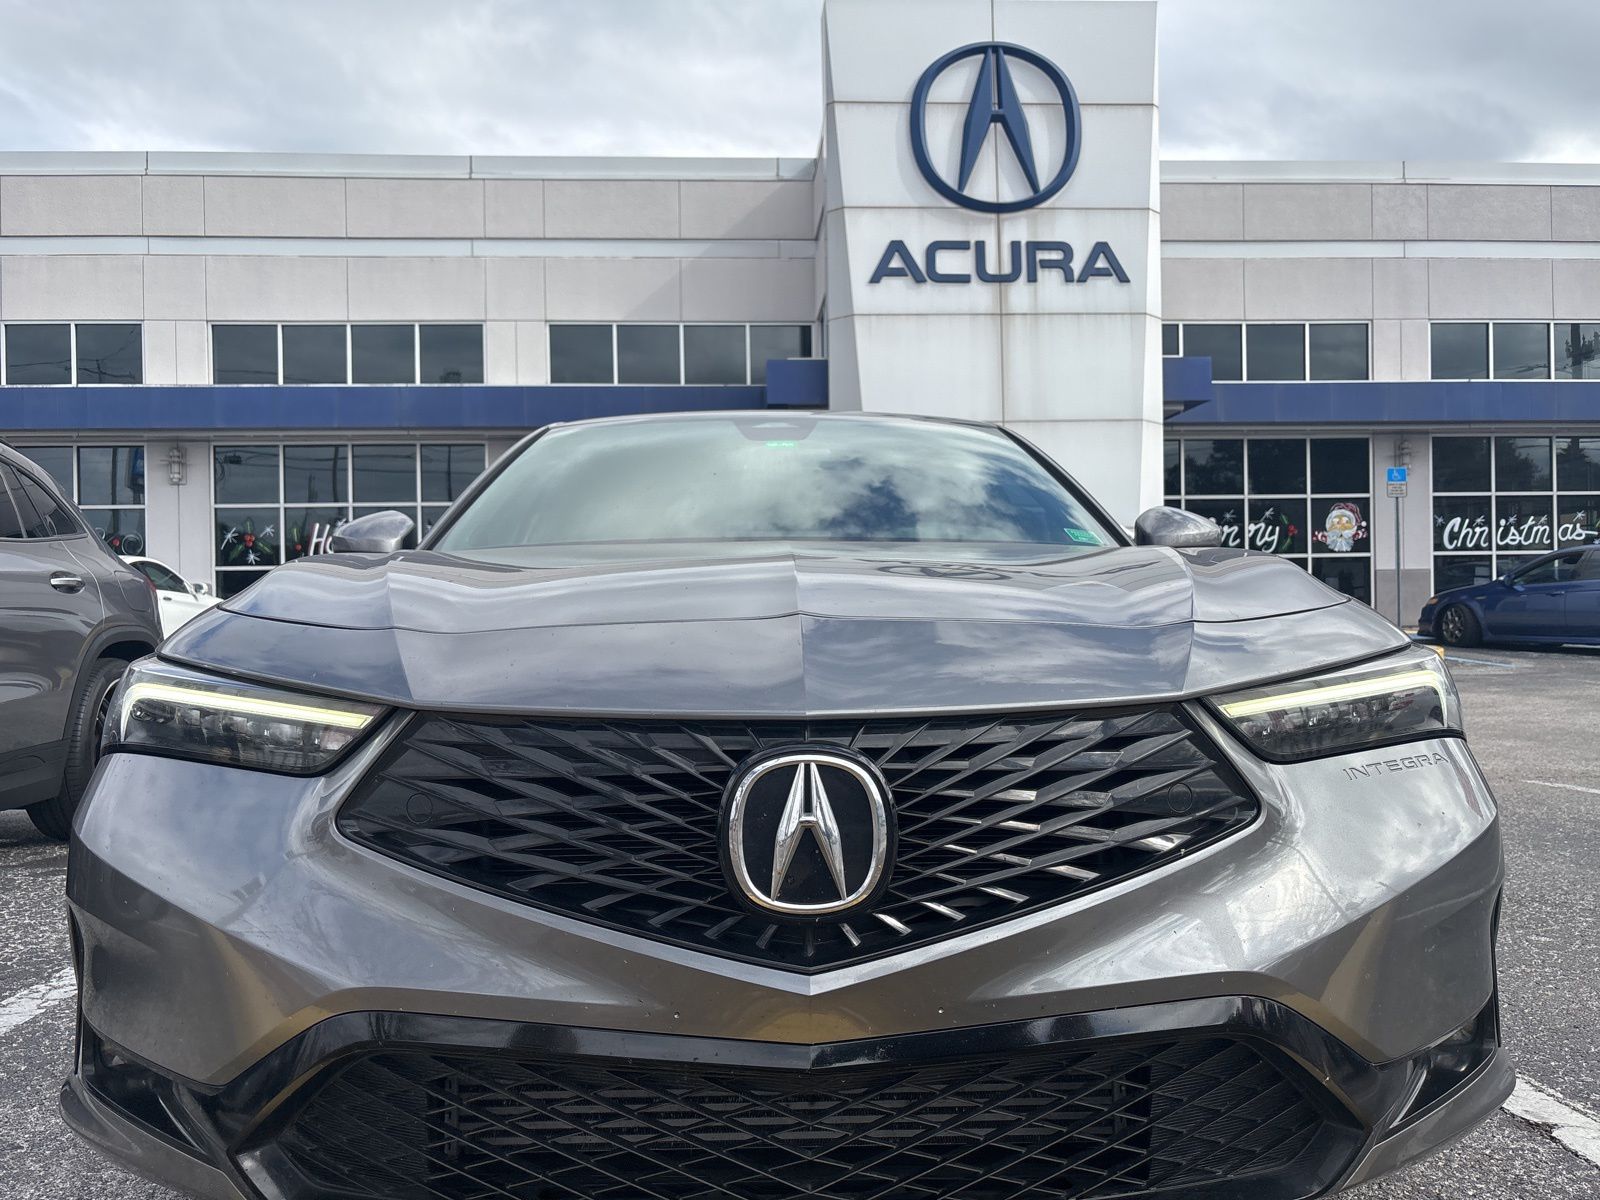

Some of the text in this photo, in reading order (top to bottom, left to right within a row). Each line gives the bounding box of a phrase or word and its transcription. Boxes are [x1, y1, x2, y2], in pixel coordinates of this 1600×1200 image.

[869, 240, 1131, 283] ACURA
[1443, 516, 1598, 549] Christmas
[1342, 752, 1449, 780] INTEGRA
